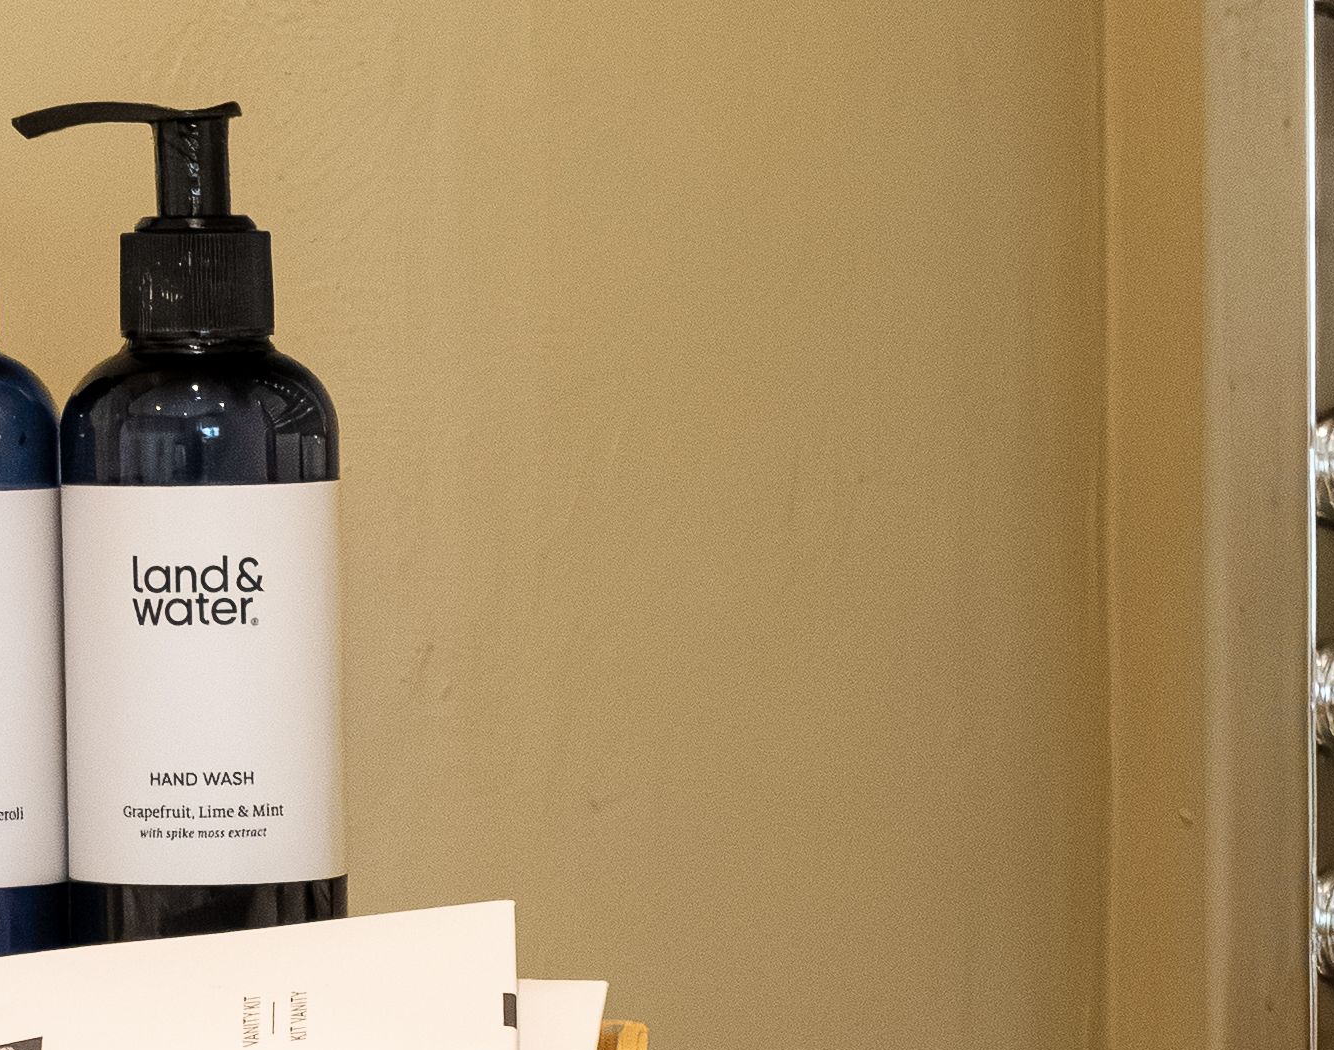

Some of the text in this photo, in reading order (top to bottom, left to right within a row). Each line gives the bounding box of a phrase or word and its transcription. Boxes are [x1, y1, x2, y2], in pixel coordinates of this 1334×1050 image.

[150, 771, 255, 787] HAND WASH
[123, 802, 284, 821] Grapefruit, Lime & Mint
[140, 827, 267, 841] with spike moss extract
